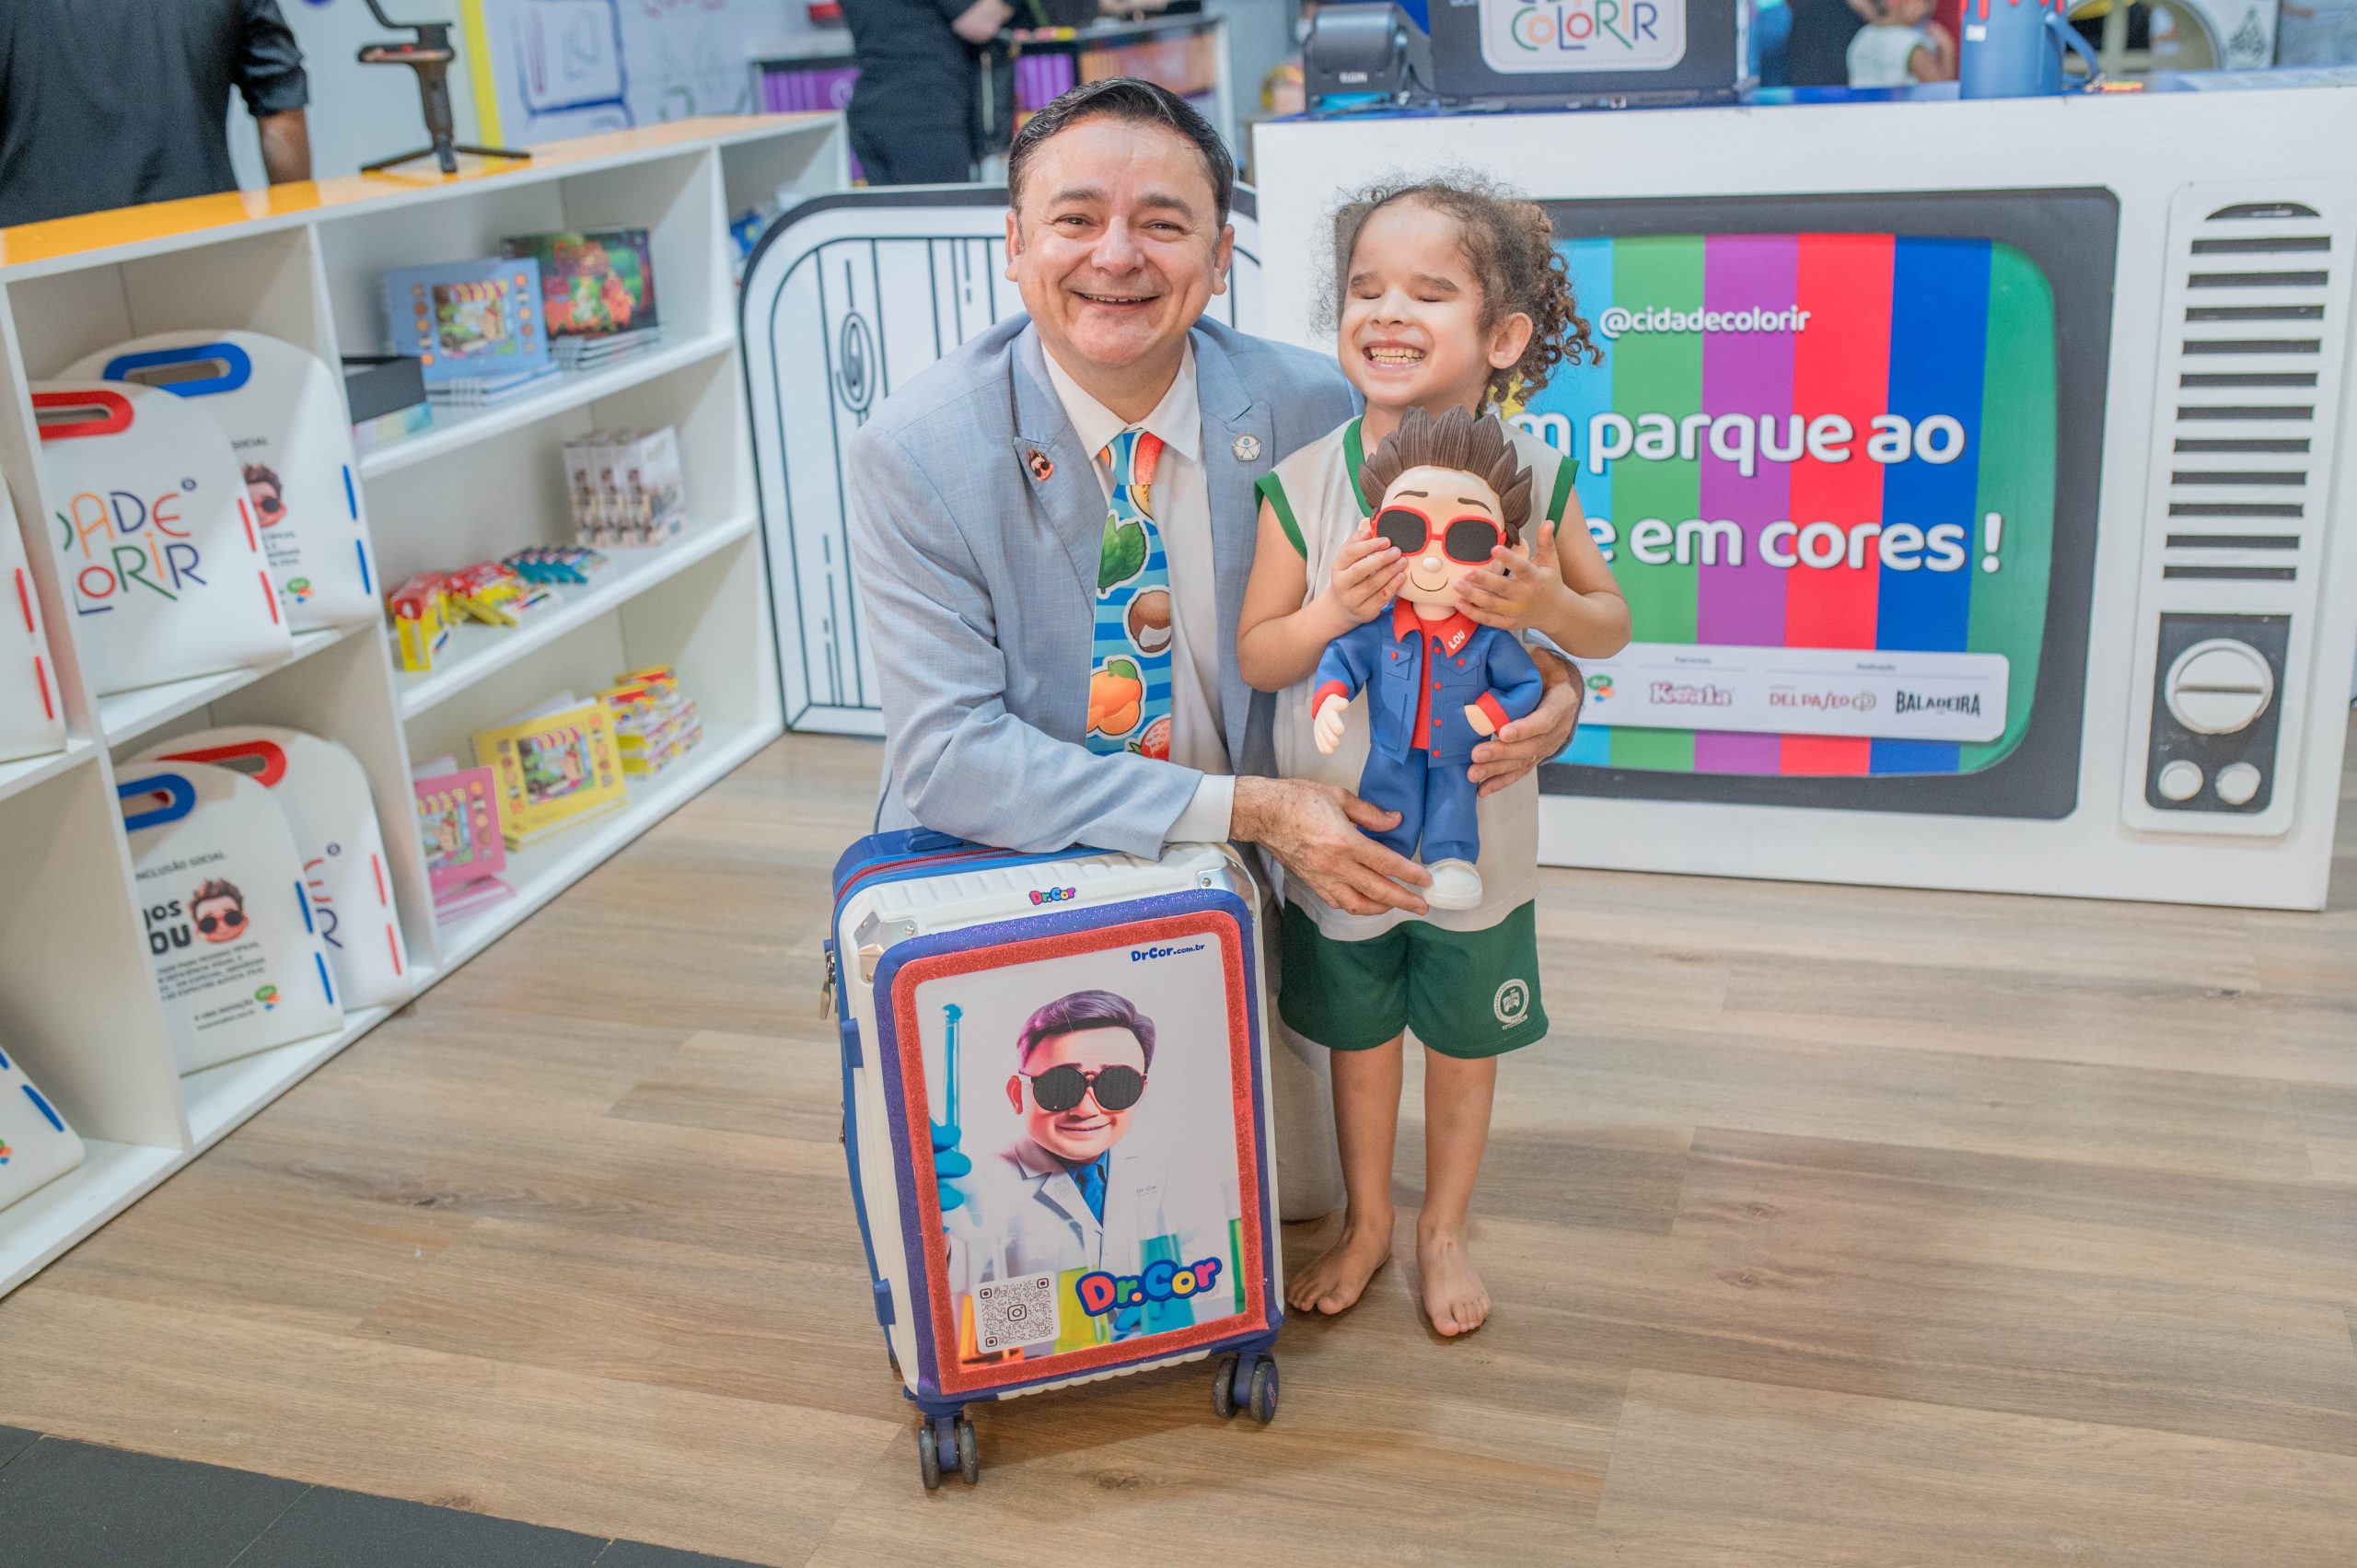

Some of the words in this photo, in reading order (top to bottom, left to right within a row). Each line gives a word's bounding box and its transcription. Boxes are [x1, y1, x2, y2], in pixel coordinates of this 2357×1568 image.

[1600, 305, 1811, 339] @cidadecolorir
[1508, 412, 1572, 458] m
[1589, 412, 1853, 477] parque
[1866, 413, 1966, 464] ao
[1630, 517, 1744, 566] em
[1759, 518, 1966, 572] cores
[1447, 630, 1467, 650] LOU
[1895, 689, 1981, 717] BALADEIRA
[1028, 887, 1076, 906] Dr.Cor
[1131, 944, 1206, 962] DrCor.com.br
[1075, 1257, 1223, 1318] Dr.Cor
